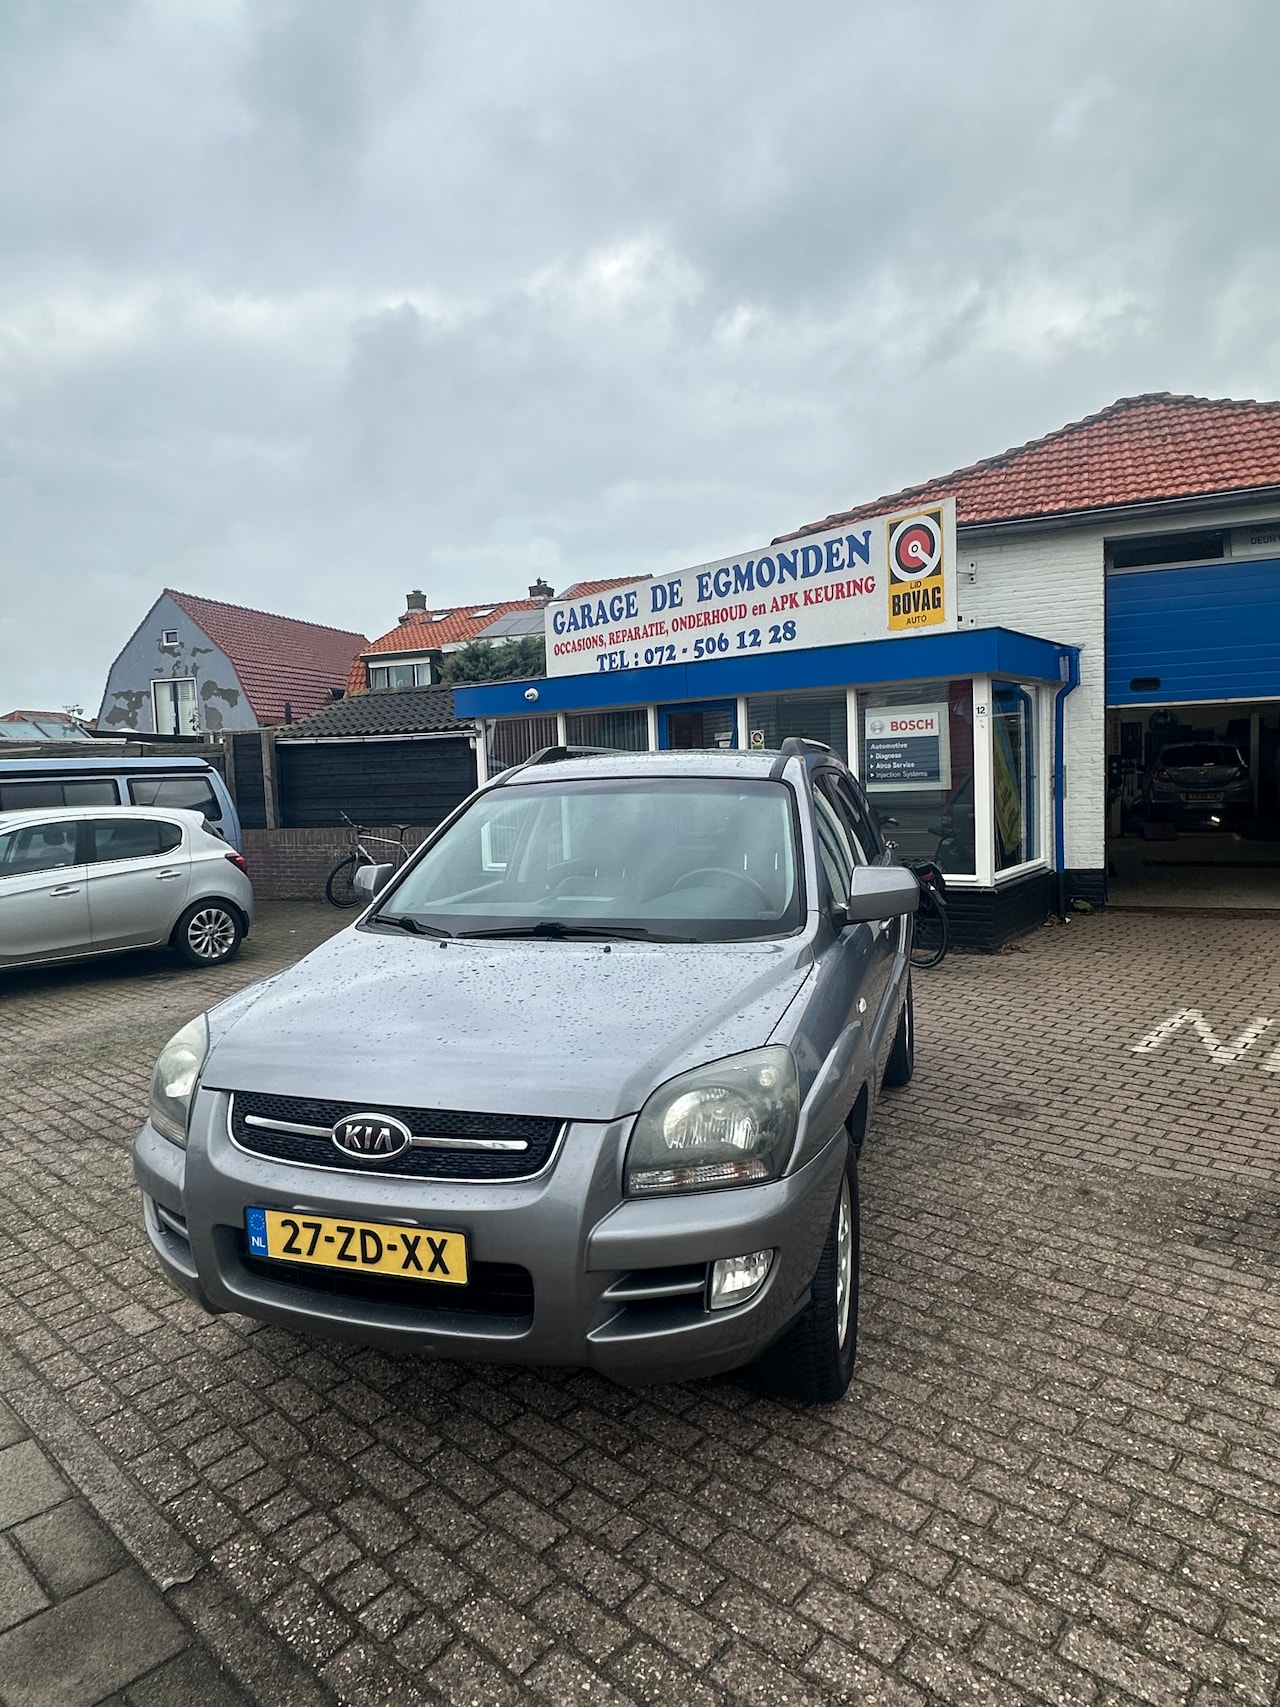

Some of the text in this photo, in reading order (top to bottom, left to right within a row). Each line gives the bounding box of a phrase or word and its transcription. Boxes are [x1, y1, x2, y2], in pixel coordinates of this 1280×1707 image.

[552, 530, 872, 635] GARAGE DE EGMONDEN
[909, 580, 922, 589] LID
[891, 586, 942, 617] BOVAG
[554, 575, 876, 656] OCCASIONS, REPARATIE, ONDERHOUD en APK KEURING
[905, 615, 927, 625] AUTO
[644, 644, 677, 665] 072
[693, 632, 730, 659] 506
[736, 628, 762, 650] 12
[768, 620, 797, 645] 28
[975, 706, 986, 715] 12
[890, 719, 934, 732] BOSCH
[870, 742, 908, 750] Automotive
[892, 761, 915, 769] Service
[902, 770, 928, 778] Systems
[344, 1125, 393, 1151] KIA
[251, 1236, 266, 1248] NL
[281, 1219, 450, 1275] 27-ZD-XX
